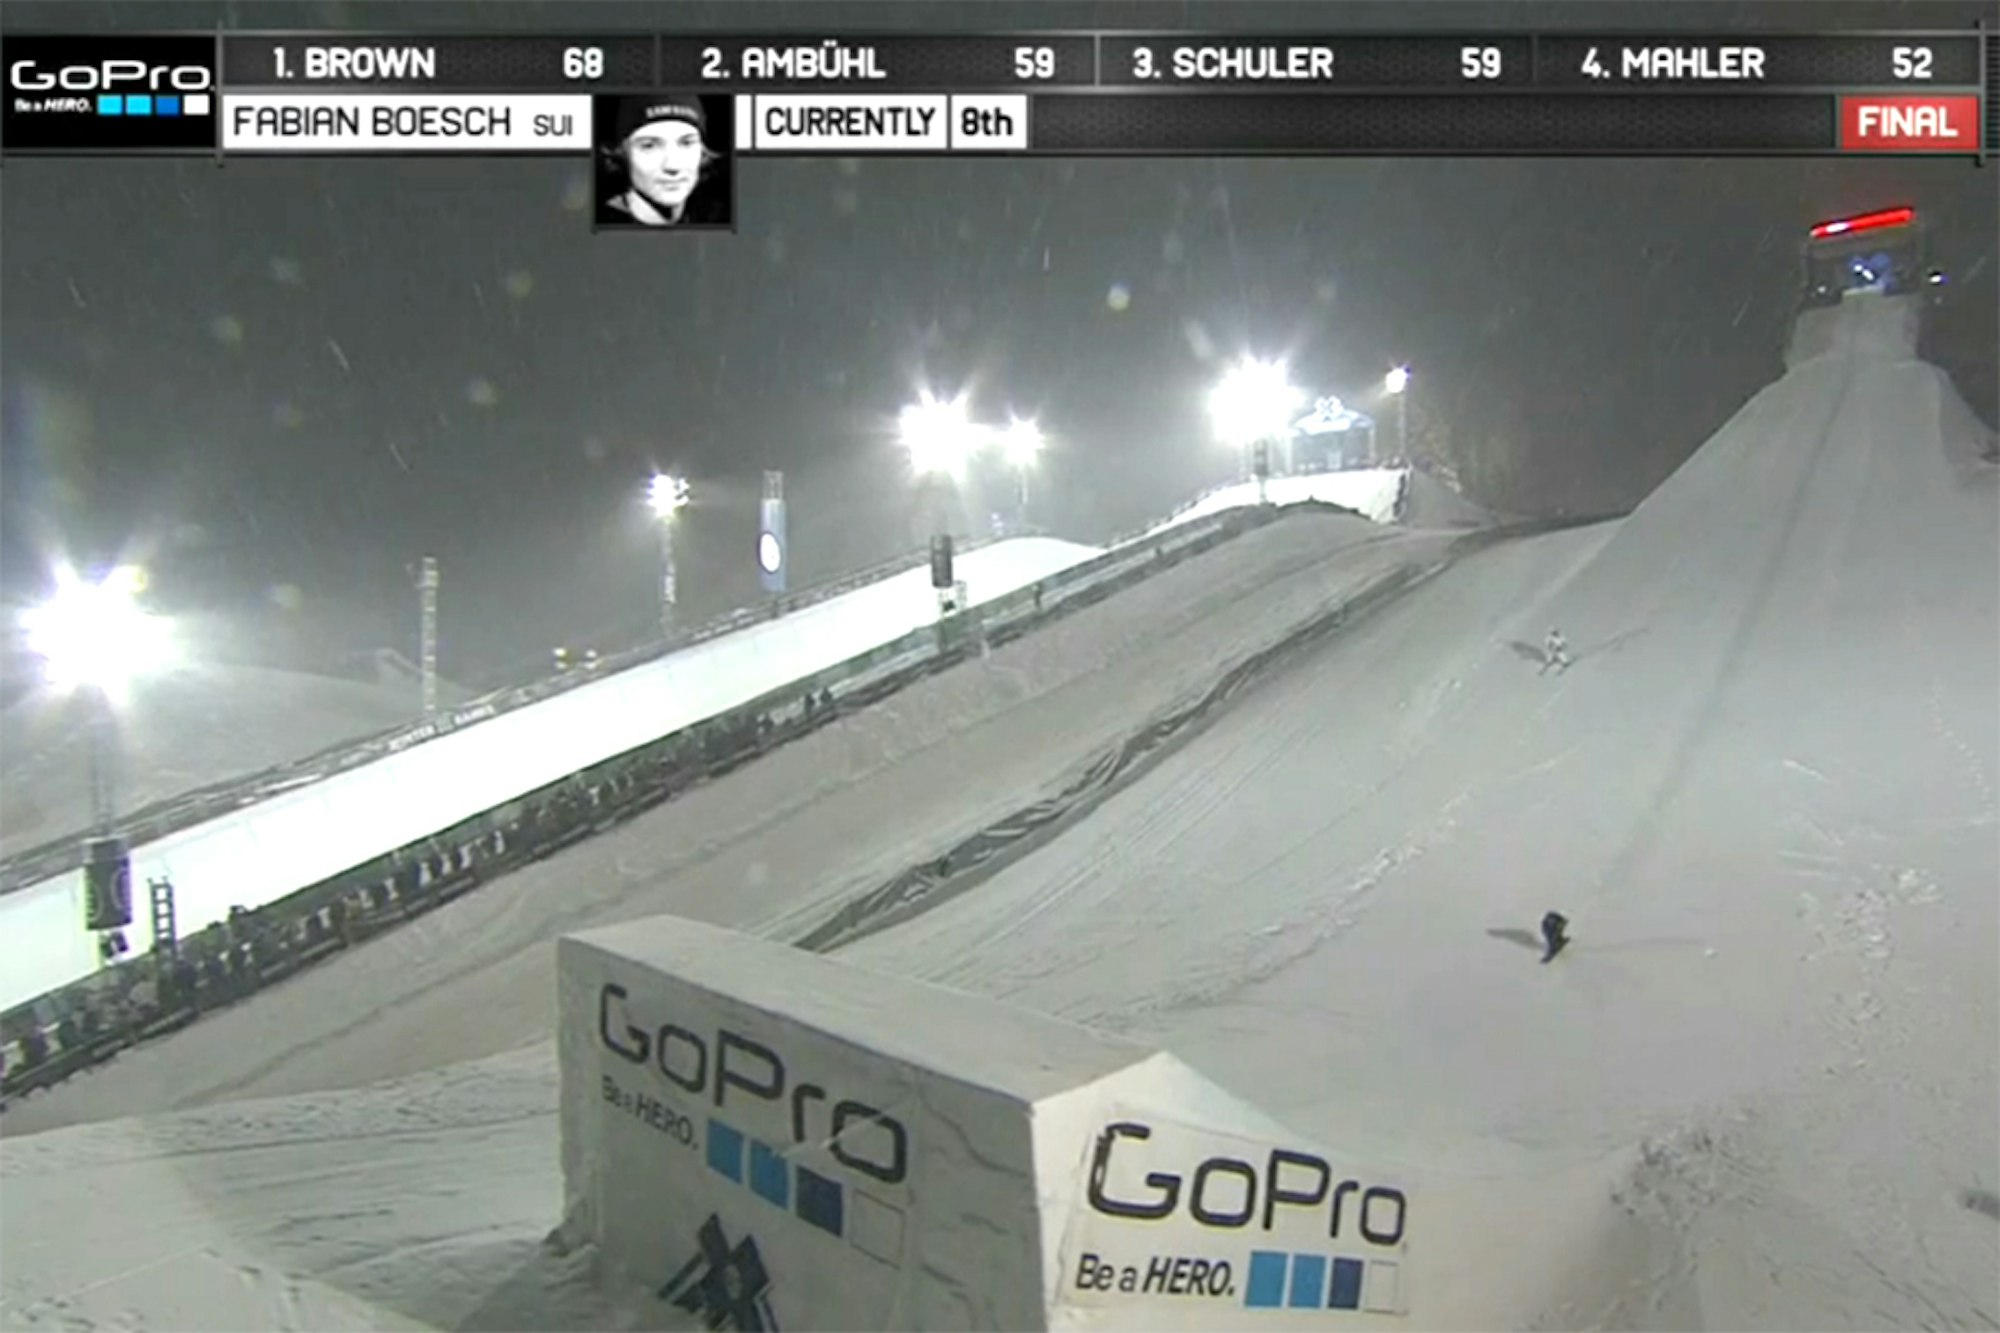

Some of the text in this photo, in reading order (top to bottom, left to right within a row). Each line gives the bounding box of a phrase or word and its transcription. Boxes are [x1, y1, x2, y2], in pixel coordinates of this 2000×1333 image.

[600, 983, 907, 1185] GoPro
[1087, 1122, 1406, 1246] GoPro
[1076, 1252, 1235, 1297] Be a HERO.
